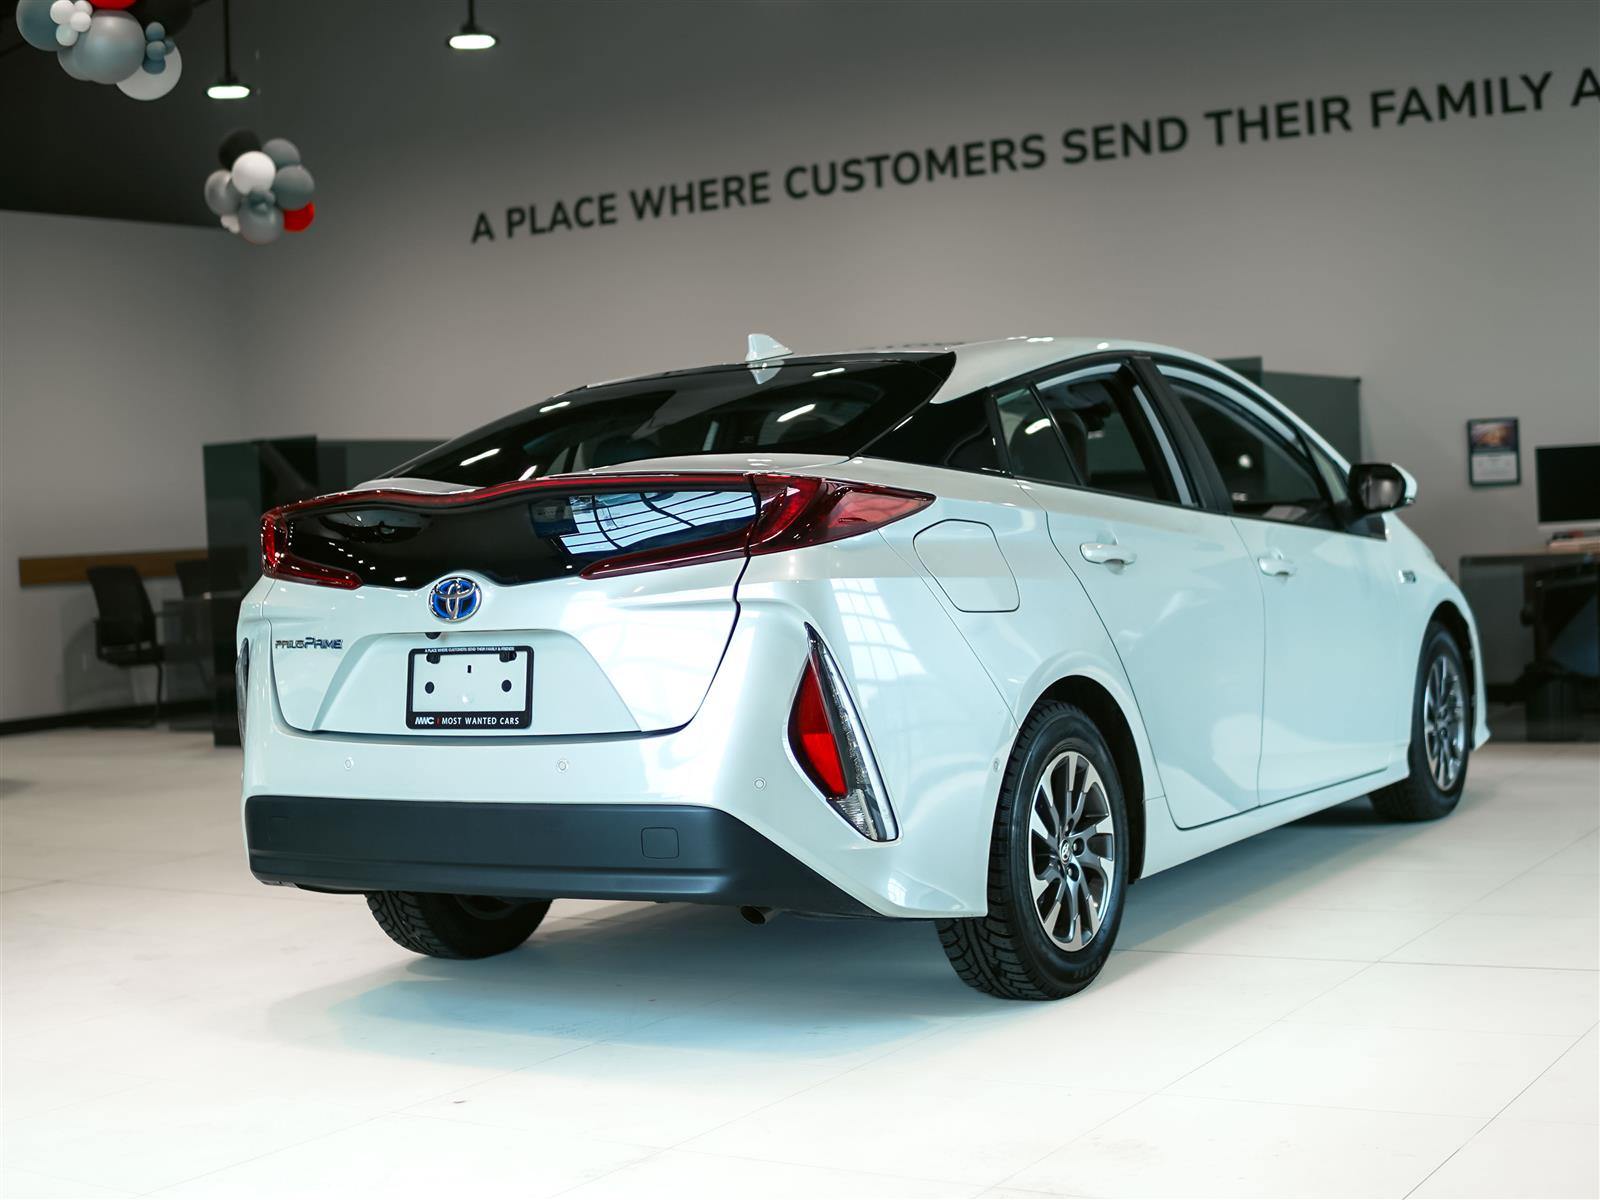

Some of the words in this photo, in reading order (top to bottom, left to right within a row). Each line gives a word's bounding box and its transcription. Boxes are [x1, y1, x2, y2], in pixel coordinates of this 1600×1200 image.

[471, 212, 496, 243] A
[506, 192, 618, 239] PLACE
[629, 170, 771, 221] WHERE
[784, 133, 1047, 200] CUSTOMERS
[1061, 116, 1189, 166] SEND
[1203, 95, 1353, 147] THEIR
[1370, 71, 1553, 129] FAMILY
[441, 716, 462, 725] MOST
[464, 716, 497, 725] WANTED
[499, 716, 520, 725] CARS
